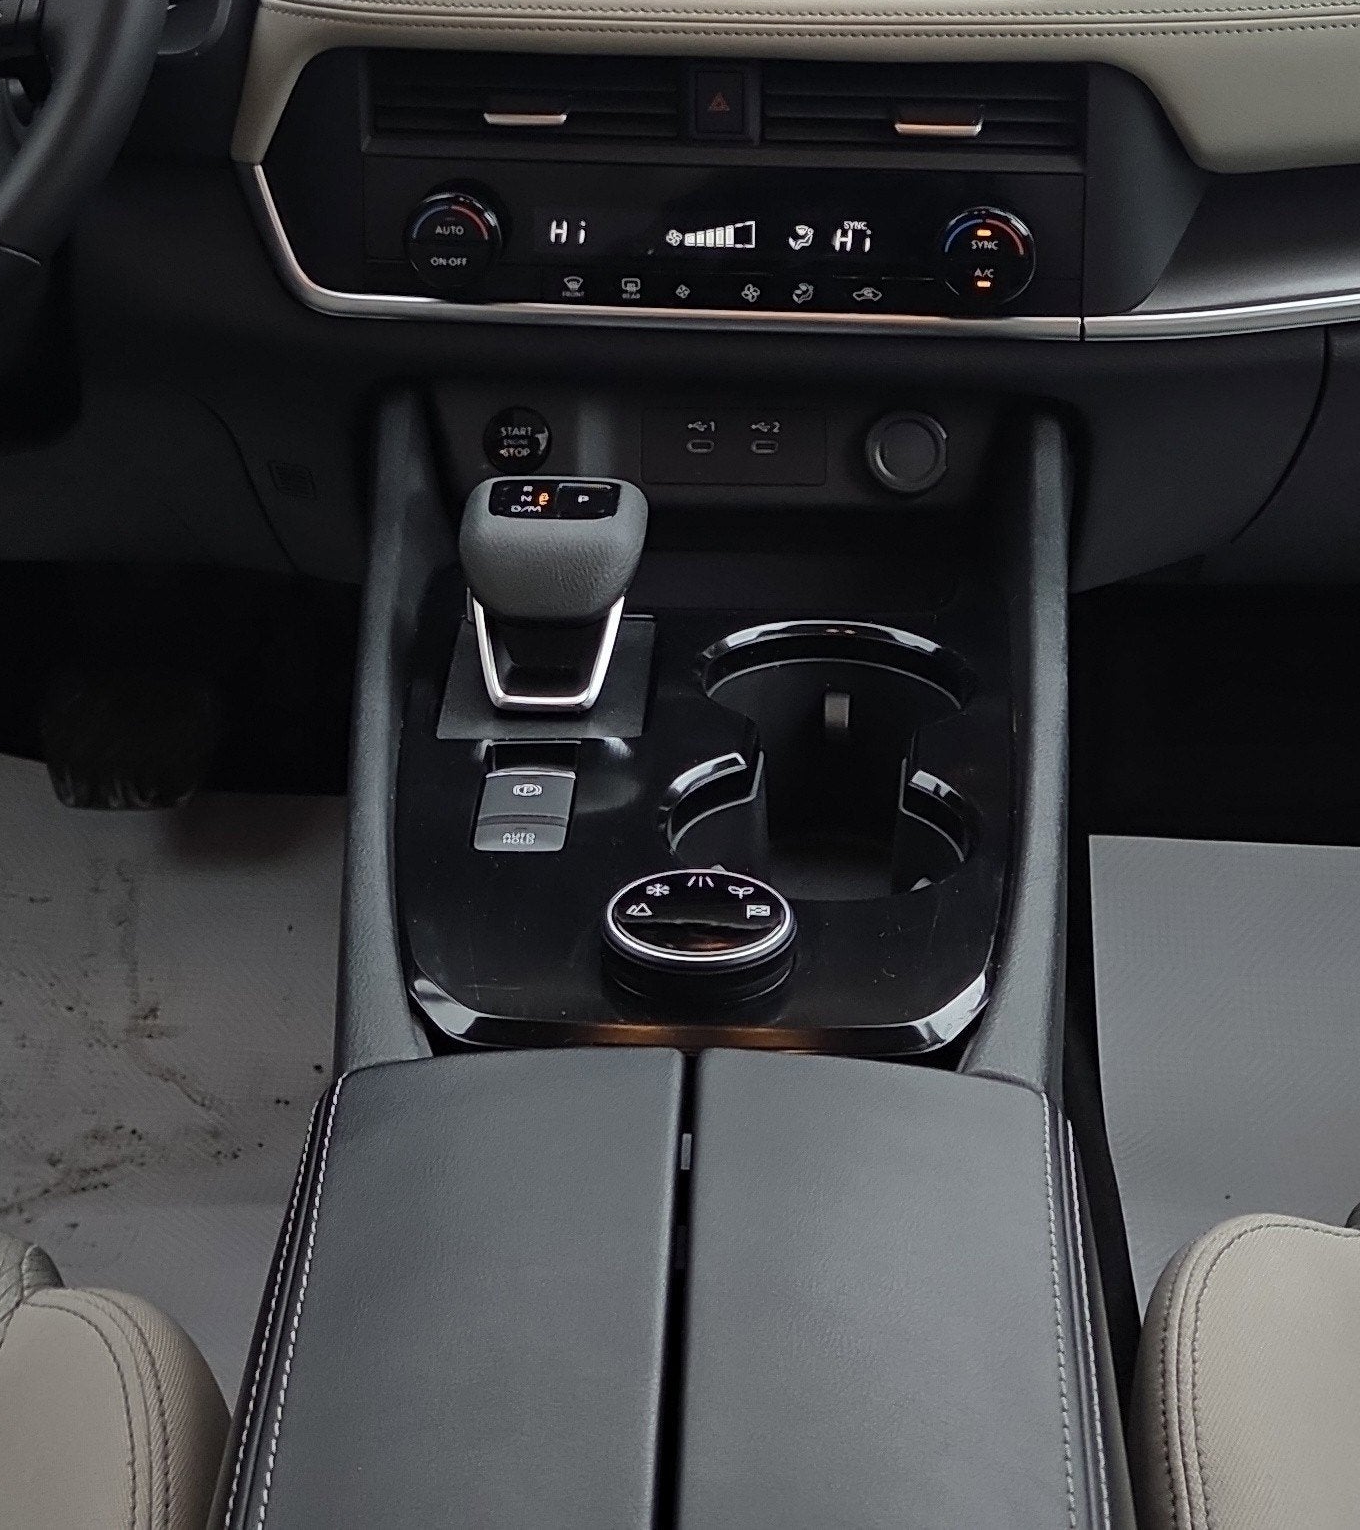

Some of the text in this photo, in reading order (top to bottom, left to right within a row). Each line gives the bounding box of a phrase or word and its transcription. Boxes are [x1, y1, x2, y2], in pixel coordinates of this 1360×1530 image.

[435, 225, 465, 236] AUTO
[843, 220, 868, 231] SYNC
[971, 239, 999, 251] SYNC
[974, 267, 994, 278] A/C
[500, 426, 533, 437] START
[710, 421, 715, 432] 1
[772, 421, 780, 433] 2
[503, 447, 531, 458] STOP
[577, 494, 590, 503] P
